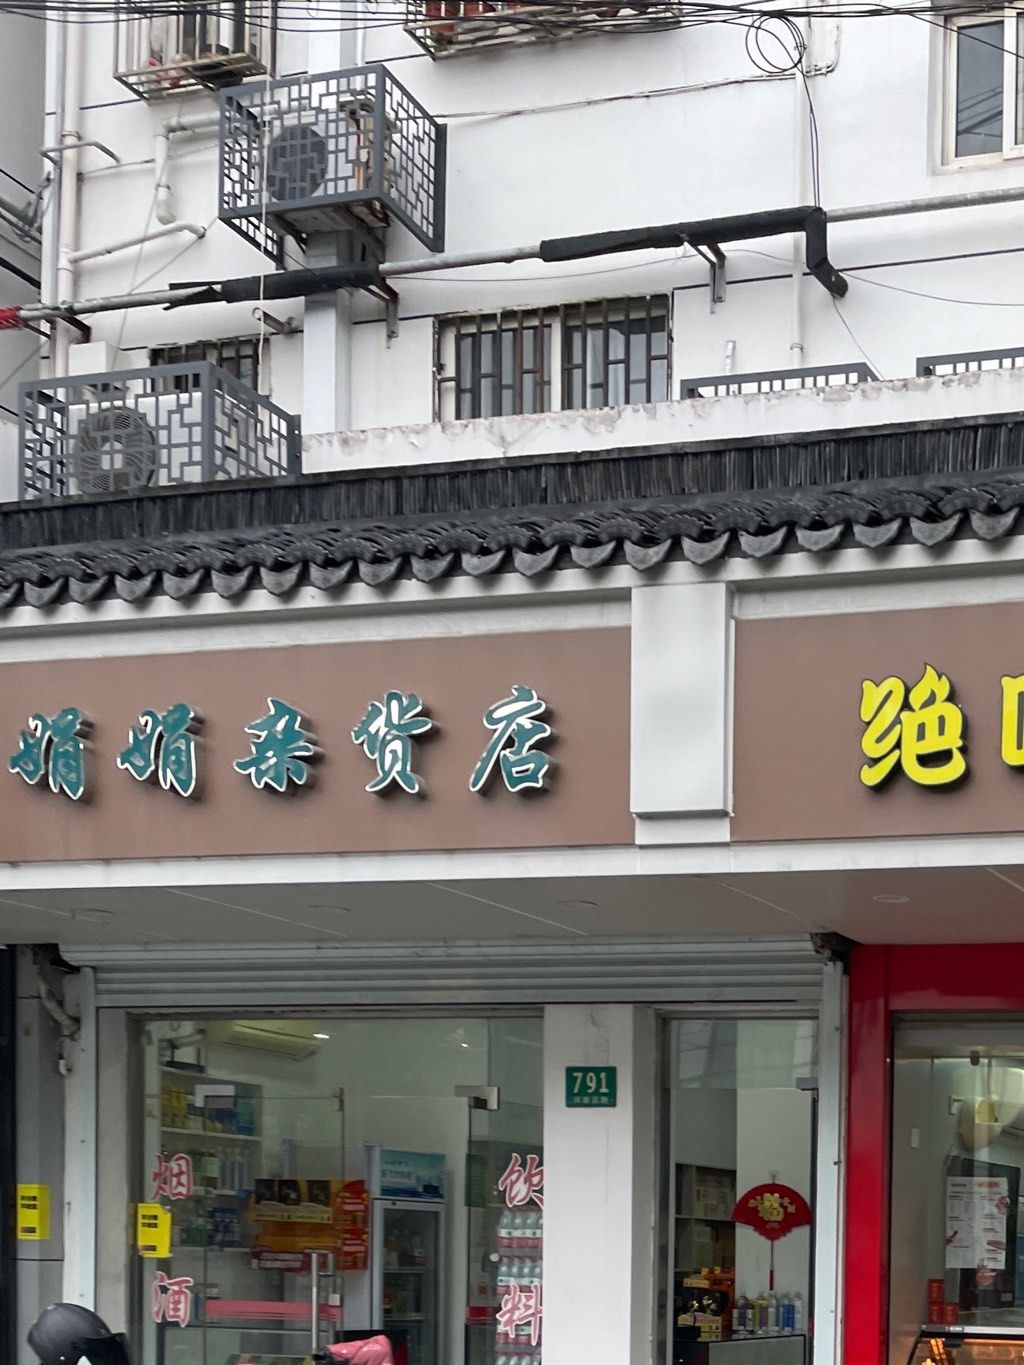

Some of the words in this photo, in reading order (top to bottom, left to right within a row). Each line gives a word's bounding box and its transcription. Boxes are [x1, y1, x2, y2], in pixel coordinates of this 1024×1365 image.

[8, 685, 560, 800] 娟娟杂货店
[572, 1072, 609, 1093] 791
